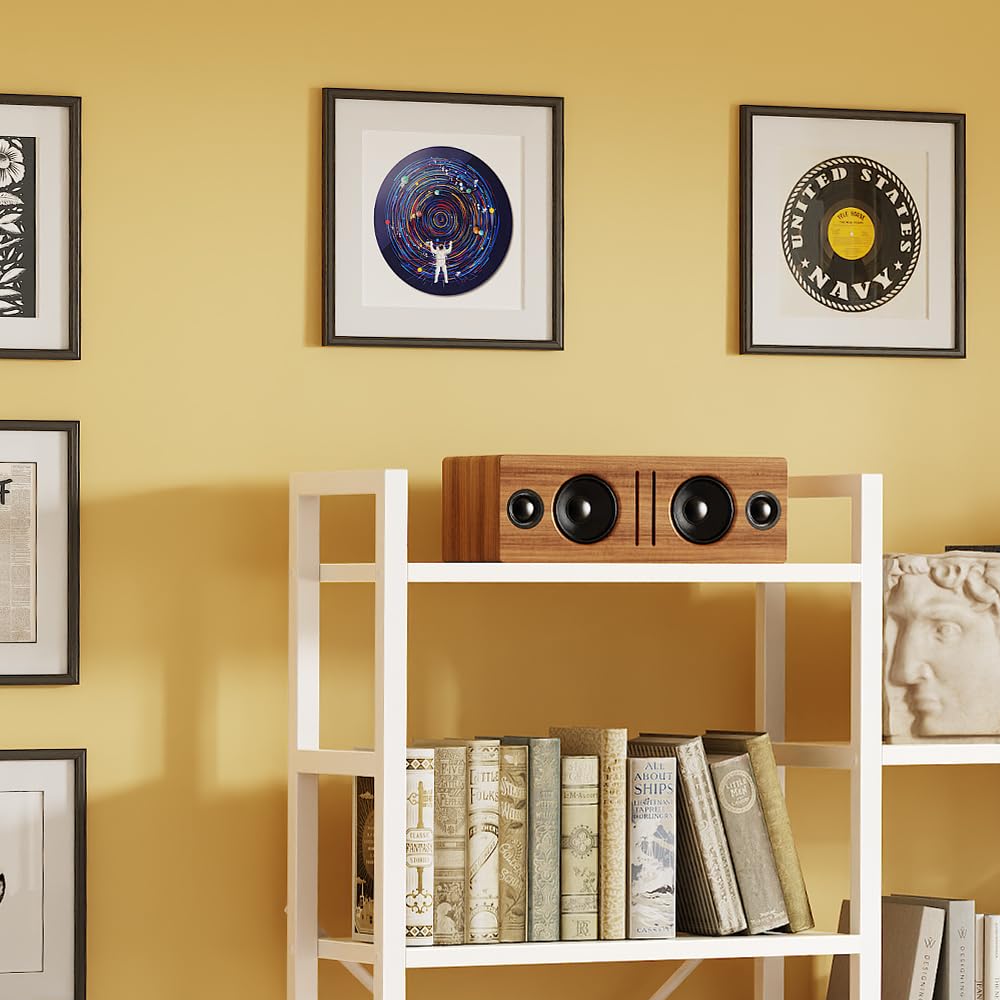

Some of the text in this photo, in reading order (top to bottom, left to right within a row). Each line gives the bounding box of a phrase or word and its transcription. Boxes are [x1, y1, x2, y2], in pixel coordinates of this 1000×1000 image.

[791, 167, 912, 253] UNITED STATES
[808, 265, 893, 301] NAVY
[645, 761, 665, 770] ALL
[633, 772, 673, 781] ABOUT
[633, 783, 674, 796] SHIPS
